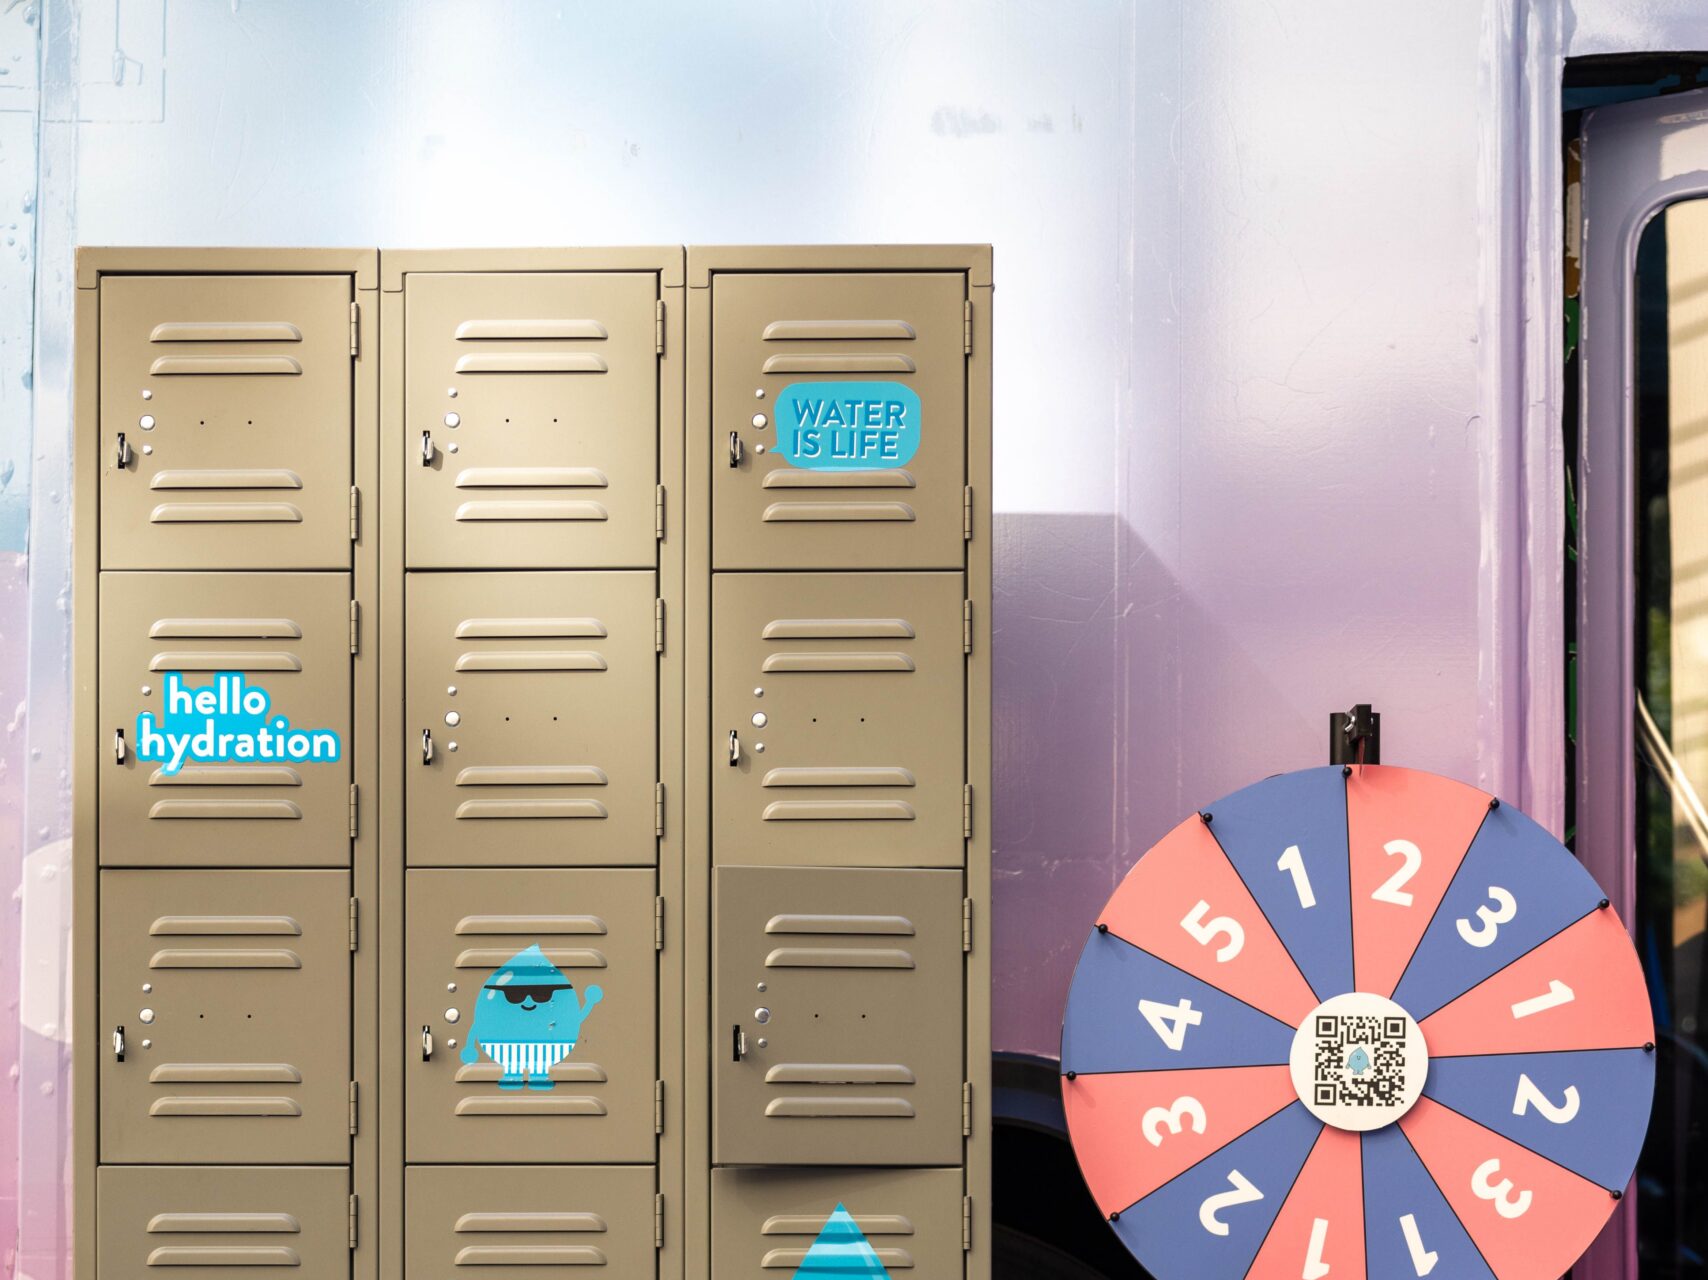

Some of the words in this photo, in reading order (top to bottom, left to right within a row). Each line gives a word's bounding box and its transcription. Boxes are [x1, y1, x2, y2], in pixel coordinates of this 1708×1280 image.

[792, 398, 907, 429] WATER
[792, 429, 822, 458] IS
[831, 430, 899, 460] LIFE
[169, 675, 266, 715] hello
[141, 718, 336, 772] hydration
[1276, 844, 1317, 909] 1
[1371, 839, 1422, 907] 2
[1180, 899, 1245, 963] 5
[1456, 886, 1517, 948] 3
[1138, 998, 1203, 1051] 4
[1511, 979, 1575, 1019] 1
[1141, 1095, 1207, 1147] 3
[1512, 1073, 1581, 1124] 2
[1199, 1169, 1264, 1236] 2
[1471, 1158, 1533, 1219] 3
[1302, 1218, 1330, 1280] 1
[1399, 1213, 1439, 1277] 1
